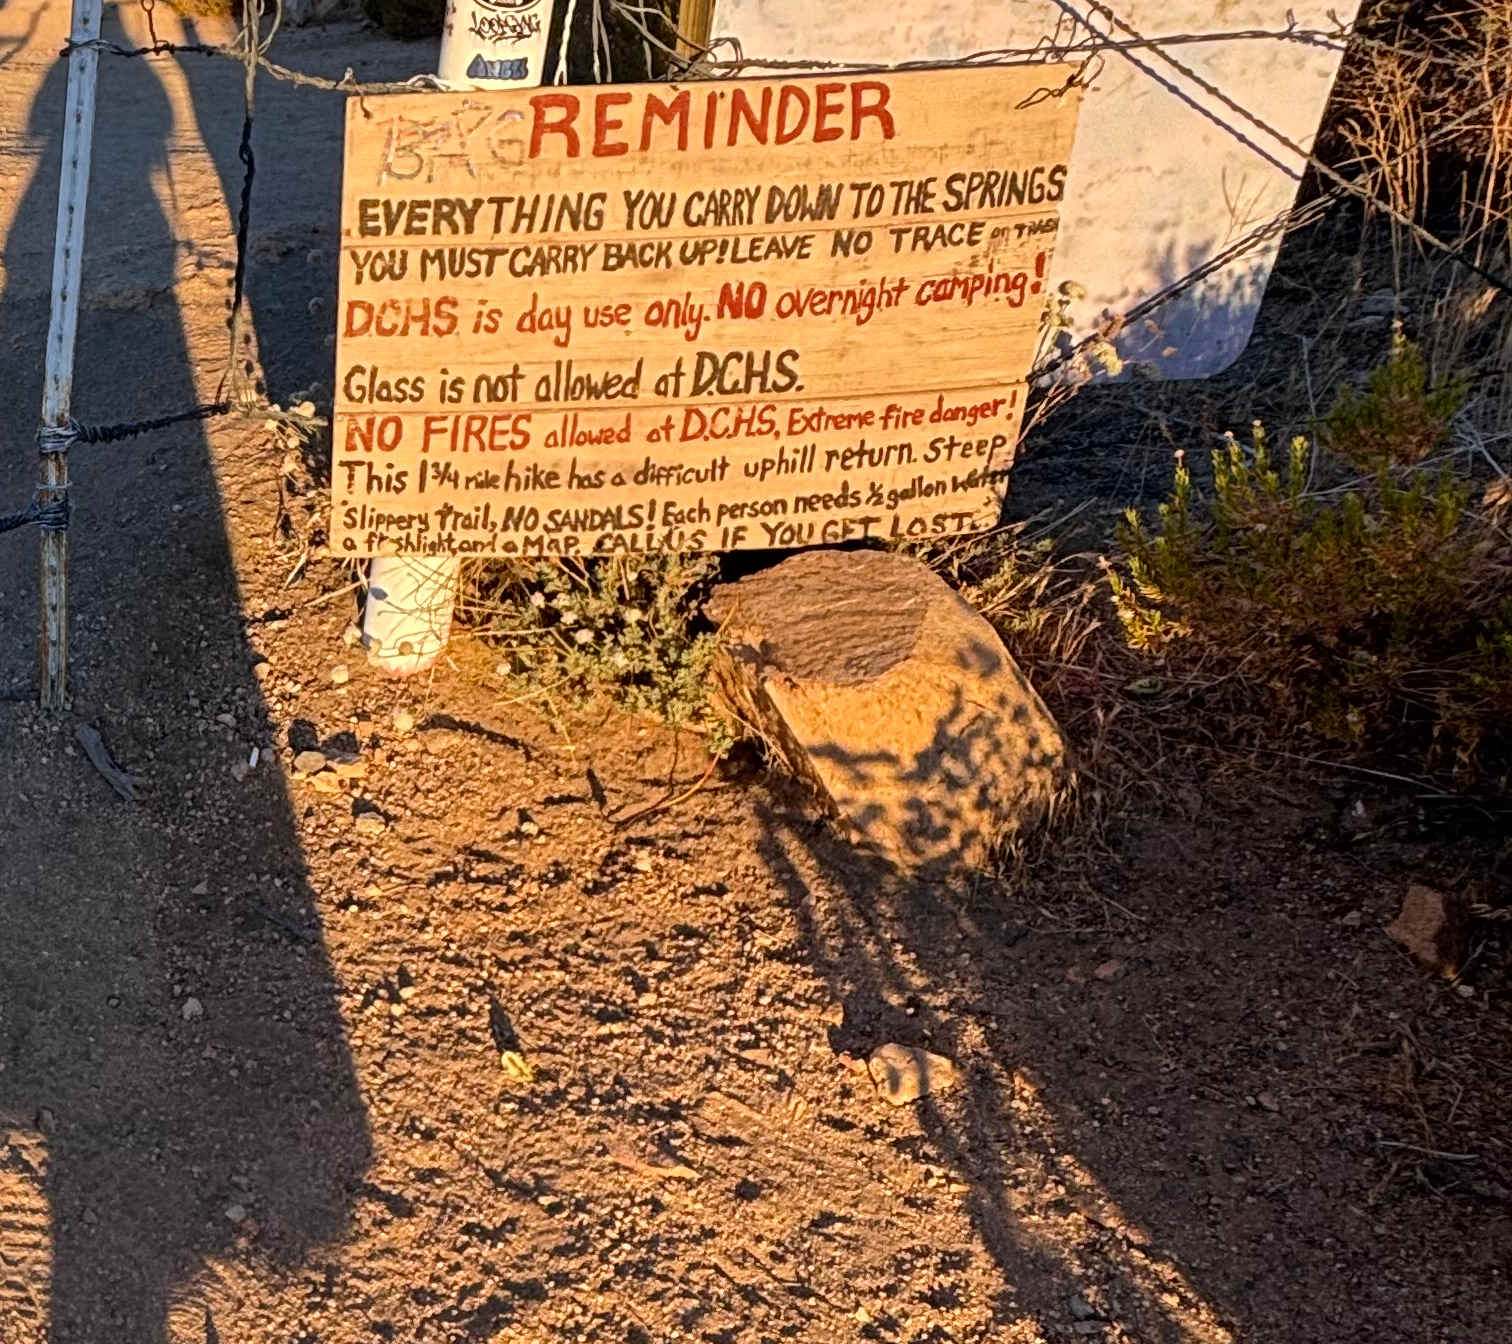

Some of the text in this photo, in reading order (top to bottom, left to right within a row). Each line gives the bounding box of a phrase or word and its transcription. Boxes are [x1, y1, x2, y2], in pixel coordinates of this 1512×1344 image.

[528, 81, 896, 159] REMINDER
[358, 164, 1068, 237] EVERYTHING YOU CARRY DOWN TO THE SPRINGS
[351, 248, 408, 285] YOU
[420, 245, 510, 282] MUST
[508, 243, 597, 276] CARRY
[602, 240, 672, 271] BACK
[831, 230, 873, 257] NO
[890, 221, 986, 253] TRACE
[472, 299, 503, 334] is
[516, 292, 571, 347] day
[584, 304, 632, 328] use
[644, 291, 710, 342] only.
[717, 281, 767, 320] NO
[776, 276, 910, 326] overnight
[915, 251, 1045, 307] camping!
[343, 364, 425, 404] Glass
[439, 367, 465, 404] is
[472, 363, 526, 404] not
[535, 357, 643, 401] allowed
[655, 357, 686, 398] at
[345, 415, 403, 452] NO
[421, 414, 531, 453] FIRES
[544, 413, 631, 448] allowed
[646, 414, 675, 443] at
[787, 406, 875, 435] Extreme
[879, 404, 925, 431] fire
[930, 390, 1017, 427] danger!
[338, 459, 408, 495] This
[464, 469, 500, 491] mile
[504, 459, 561, 492] hike
[568, 456, 606, 489] has
[611, 472, 627, 487] a
[633, 455, 730, 487] difficult
[744, 443, 816, 482] uphill
[825, 439, 918, 473] return.
[342, 504, 430, 533] Slippery
[501, 505, 539, 533] NO
[543, 498, 657, 533] SANDALS!
[662, 497, 711, 527] Each
[716, 498, 787, 527] person
[794, 480, 862, 514] needs
[886, 475, 947, 510] gallon
[343, 537, 357, 553] a
[458, 533, 497, 553] and
[502, 541, 519, 553] a
[662, 527, 707, 553] US
[722, 525, 748, 548] IF
[759, 521, 814, 546] YOU
[822, 516, 882, 544] GET
